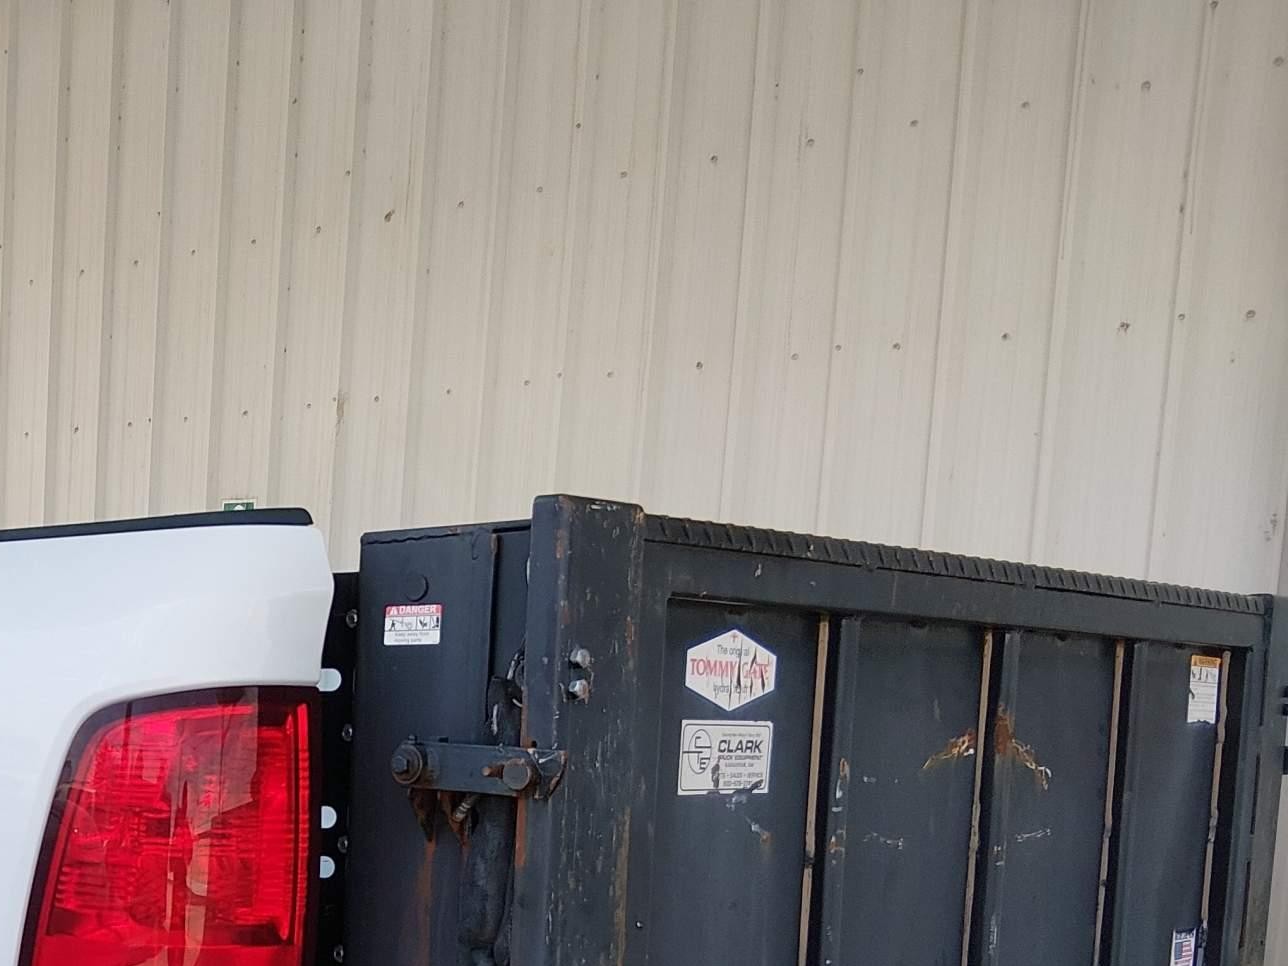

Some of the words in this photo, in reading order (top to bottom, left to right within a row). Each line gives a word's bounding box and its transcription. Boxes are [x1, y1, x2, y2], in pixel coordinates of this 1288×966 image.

[399, 605, 435, 615] DANGER
[690, 658, 737, 678] TOMMY
[718, 739, 763, 753] CLARK
